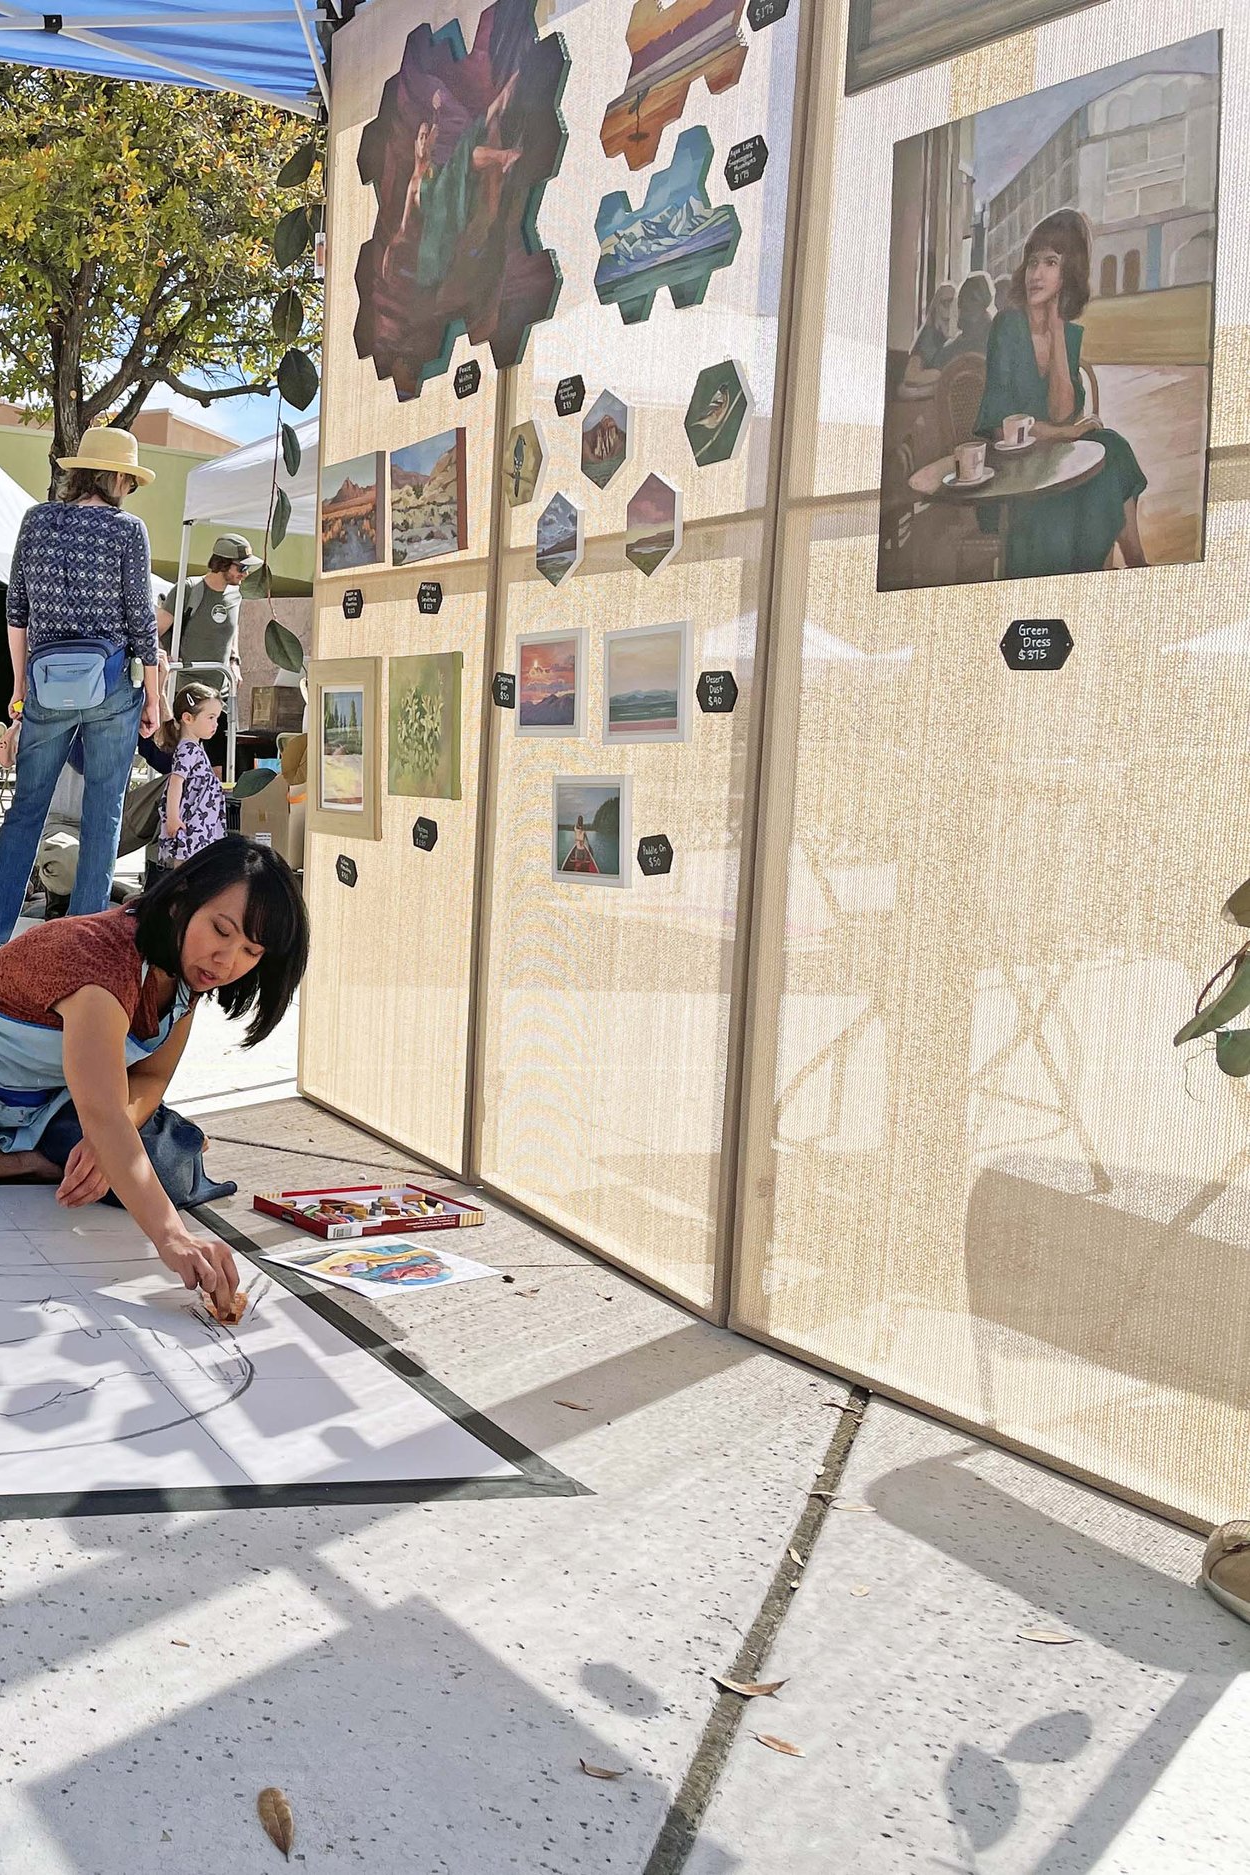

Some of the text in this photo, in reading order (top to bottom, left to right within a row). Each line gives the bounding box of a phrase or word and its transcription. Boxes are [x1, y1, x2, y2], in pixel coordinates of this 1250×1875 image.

[1018, 624, 1049, 636] Green
[1023, 637, 1051, 648] Dress
[1017, 648, 1047, 661] $375
[705, 675, 725, 684] Desert
[709, 684, 724, 694] Dust
[642, 843, 667, 856] Paddle On
[648, 856, 662, 868] $50
